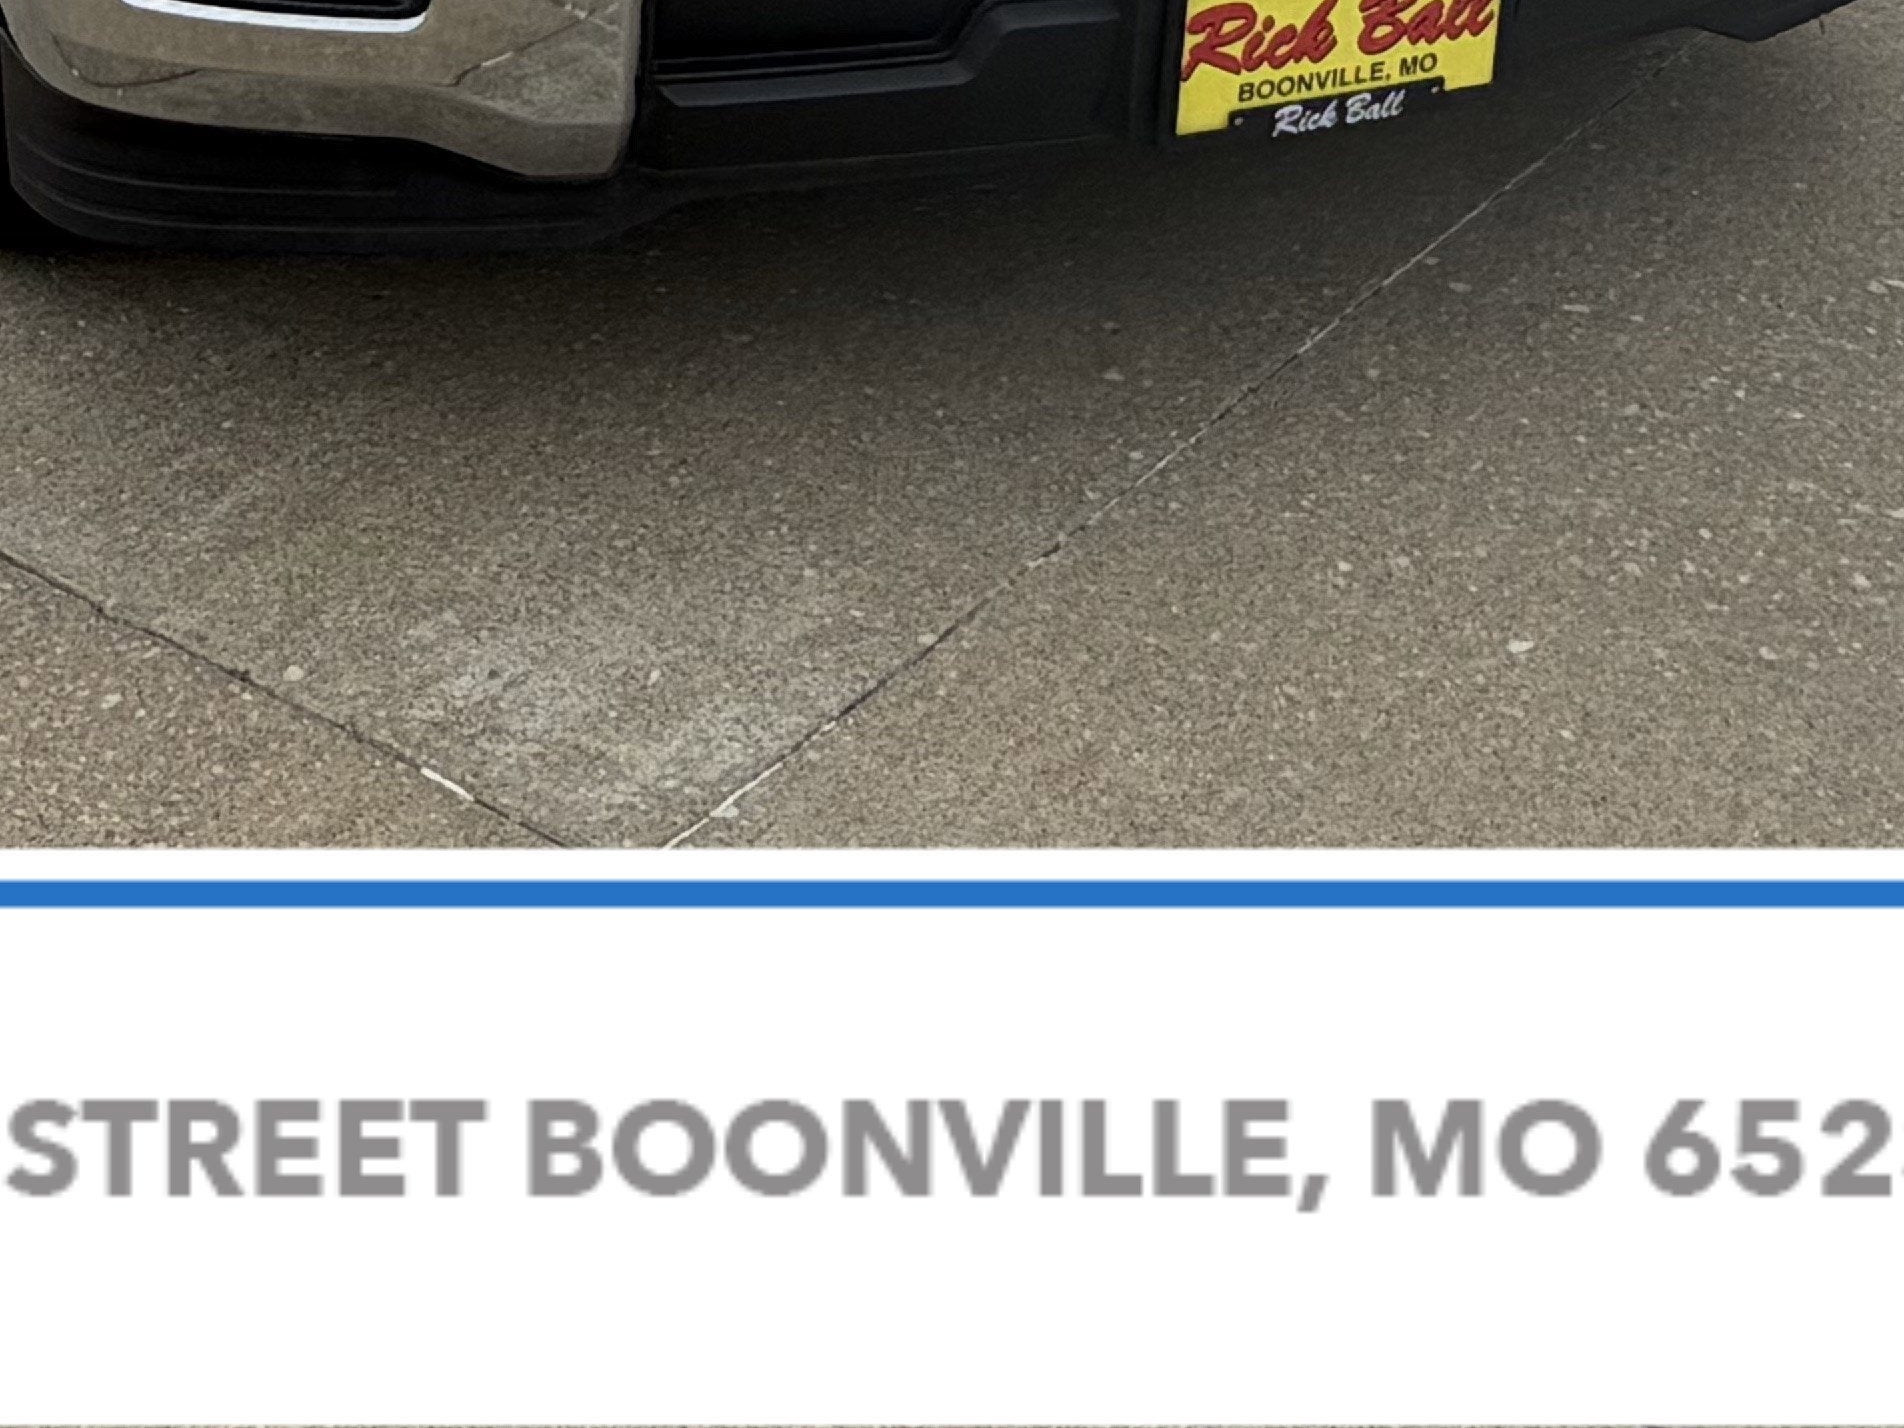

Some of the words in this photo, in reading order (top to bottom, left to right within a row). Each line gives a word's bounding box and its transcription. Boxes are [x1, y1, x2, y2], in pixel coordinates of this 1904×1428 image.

[1238, 60, 1391, 102] BOONVILLE,
[1399, 52, 1438, 76] MO
[1272, 100, 1337, 138] Rick
[1344, 90, 1404, 125] Ball
